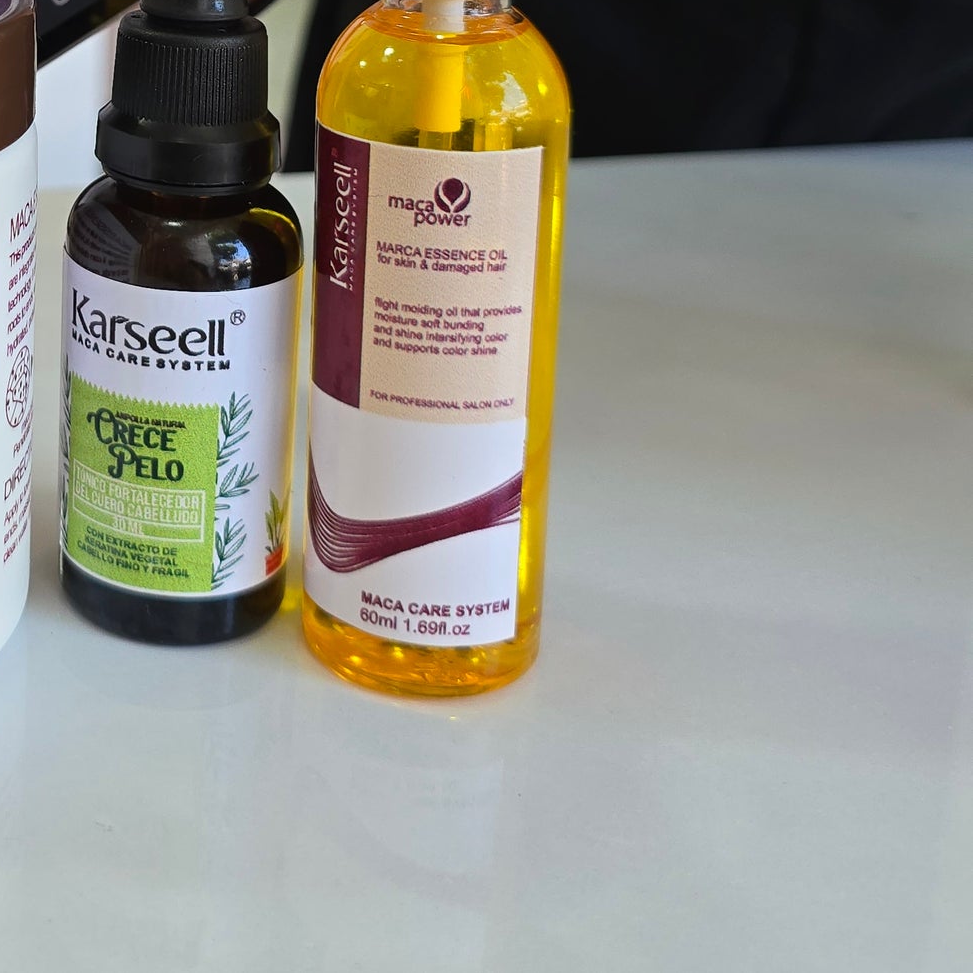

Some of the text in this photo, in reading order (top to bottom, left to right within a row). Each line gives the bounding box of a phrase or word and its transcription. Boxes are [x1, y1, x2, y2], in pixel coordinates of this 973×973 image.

[388, 194, 435, 213] maca
[329, 161, 352, 290] Karseell
[413, 211, 472, 227] power
[377, 240, 508, 261] MARCA ESSENCE OIL
[377, 252, 506, 276] for skin & damaged hair
[374, 311, 418, 326] moisture
[420, 318, 440, 329] soft
[461, 307, 481, 317] that
[483, 304, 523, 319] provides
[373, 323, 509, 343] and shine color
[71, 328, 231, 371] MACA CARE SYSTEM
[373, 336, 498, 356] and supports color shine
[370, 389, 515, 410] FOR PROFESSIONAL SALON ONLY
[86, 407, 177, 452] CRECE
[107, 442, 185, 483] PELO
[75, 480, 199, 524] DEL CUERO CABELLUDO
[87, 525, 178, 556] CON EXTRACTO DE
[77, 539, 114, 565] CABELLO
[115, 558, 140, 571] FINO
[142, 565, 150, 573] Y
[130, 551, 178, 567] VEGETAL
[361, 590, 510, 617] MACA CARE SYSTEM
[360, 607, 397, 630] 60ml
